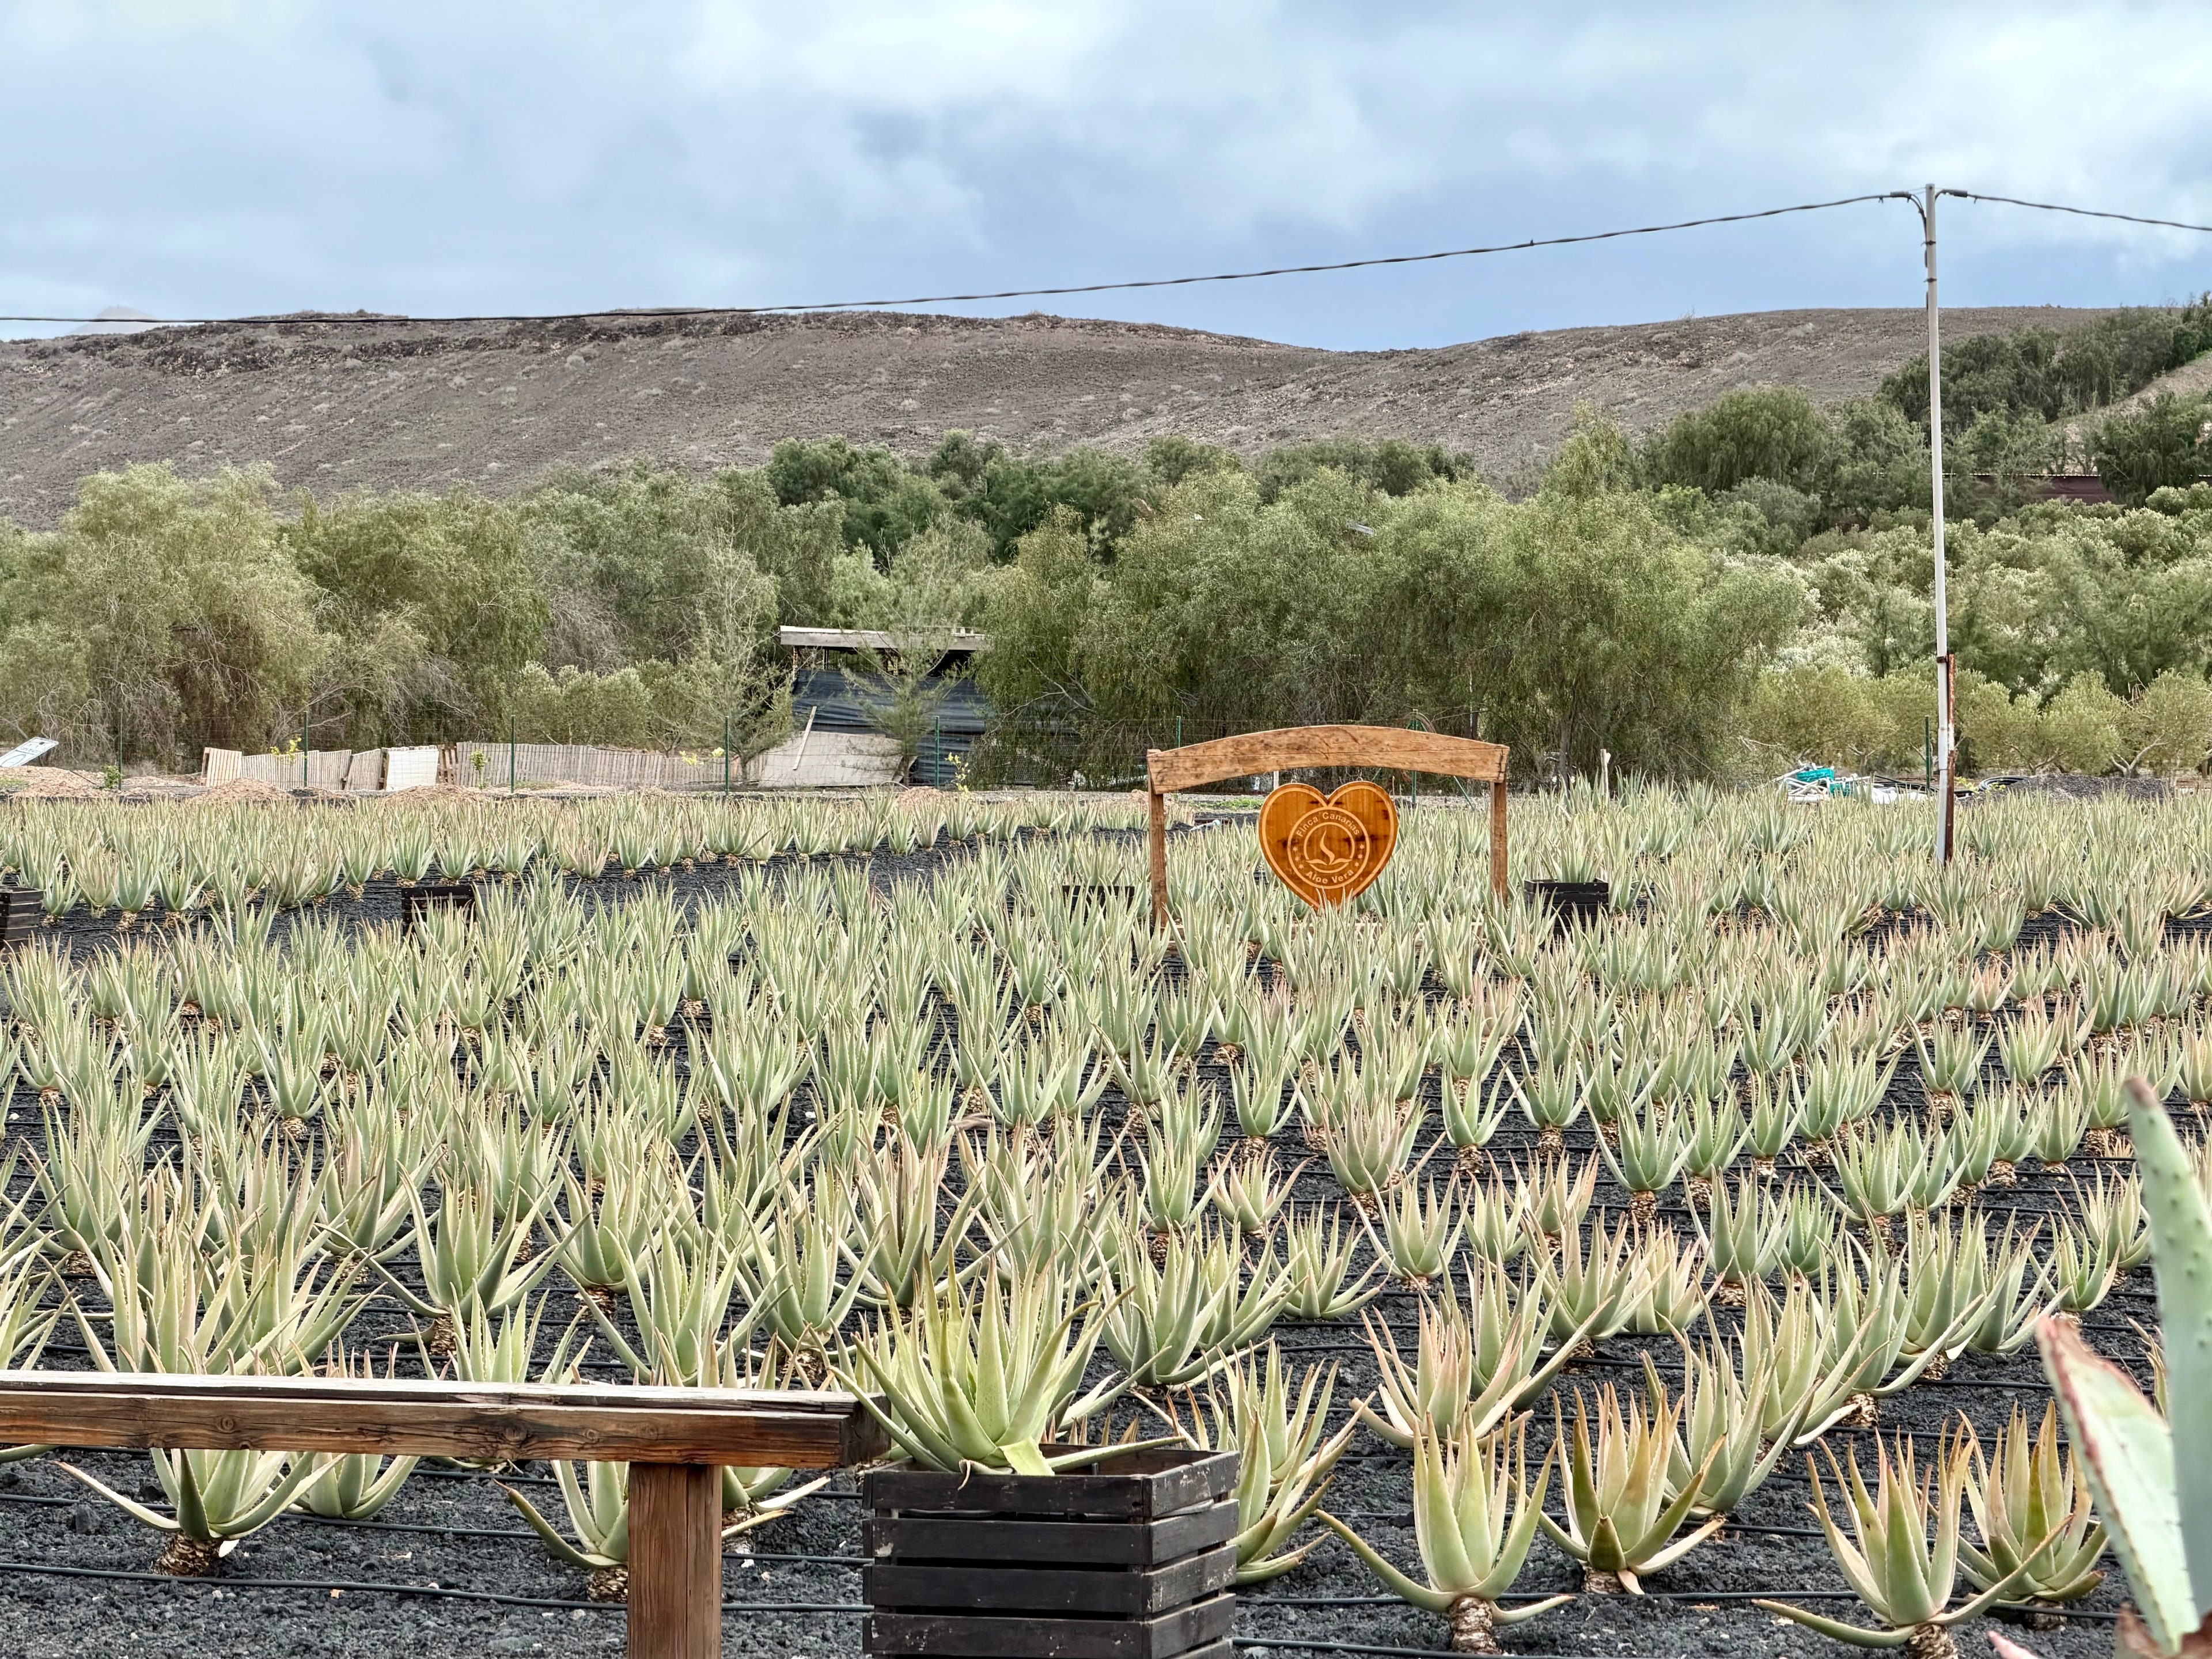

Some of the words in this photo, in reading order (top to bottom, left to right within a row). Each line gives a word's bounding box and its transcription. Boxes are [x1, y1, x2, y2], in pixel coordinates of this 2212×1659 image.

[1296, 816, 1319, 838] Finca
[1322, 812, 1359, 836] Canarias
[1305, 871, 1328, 884] Aloe
[1331, 869, 1354, 884] Vera
